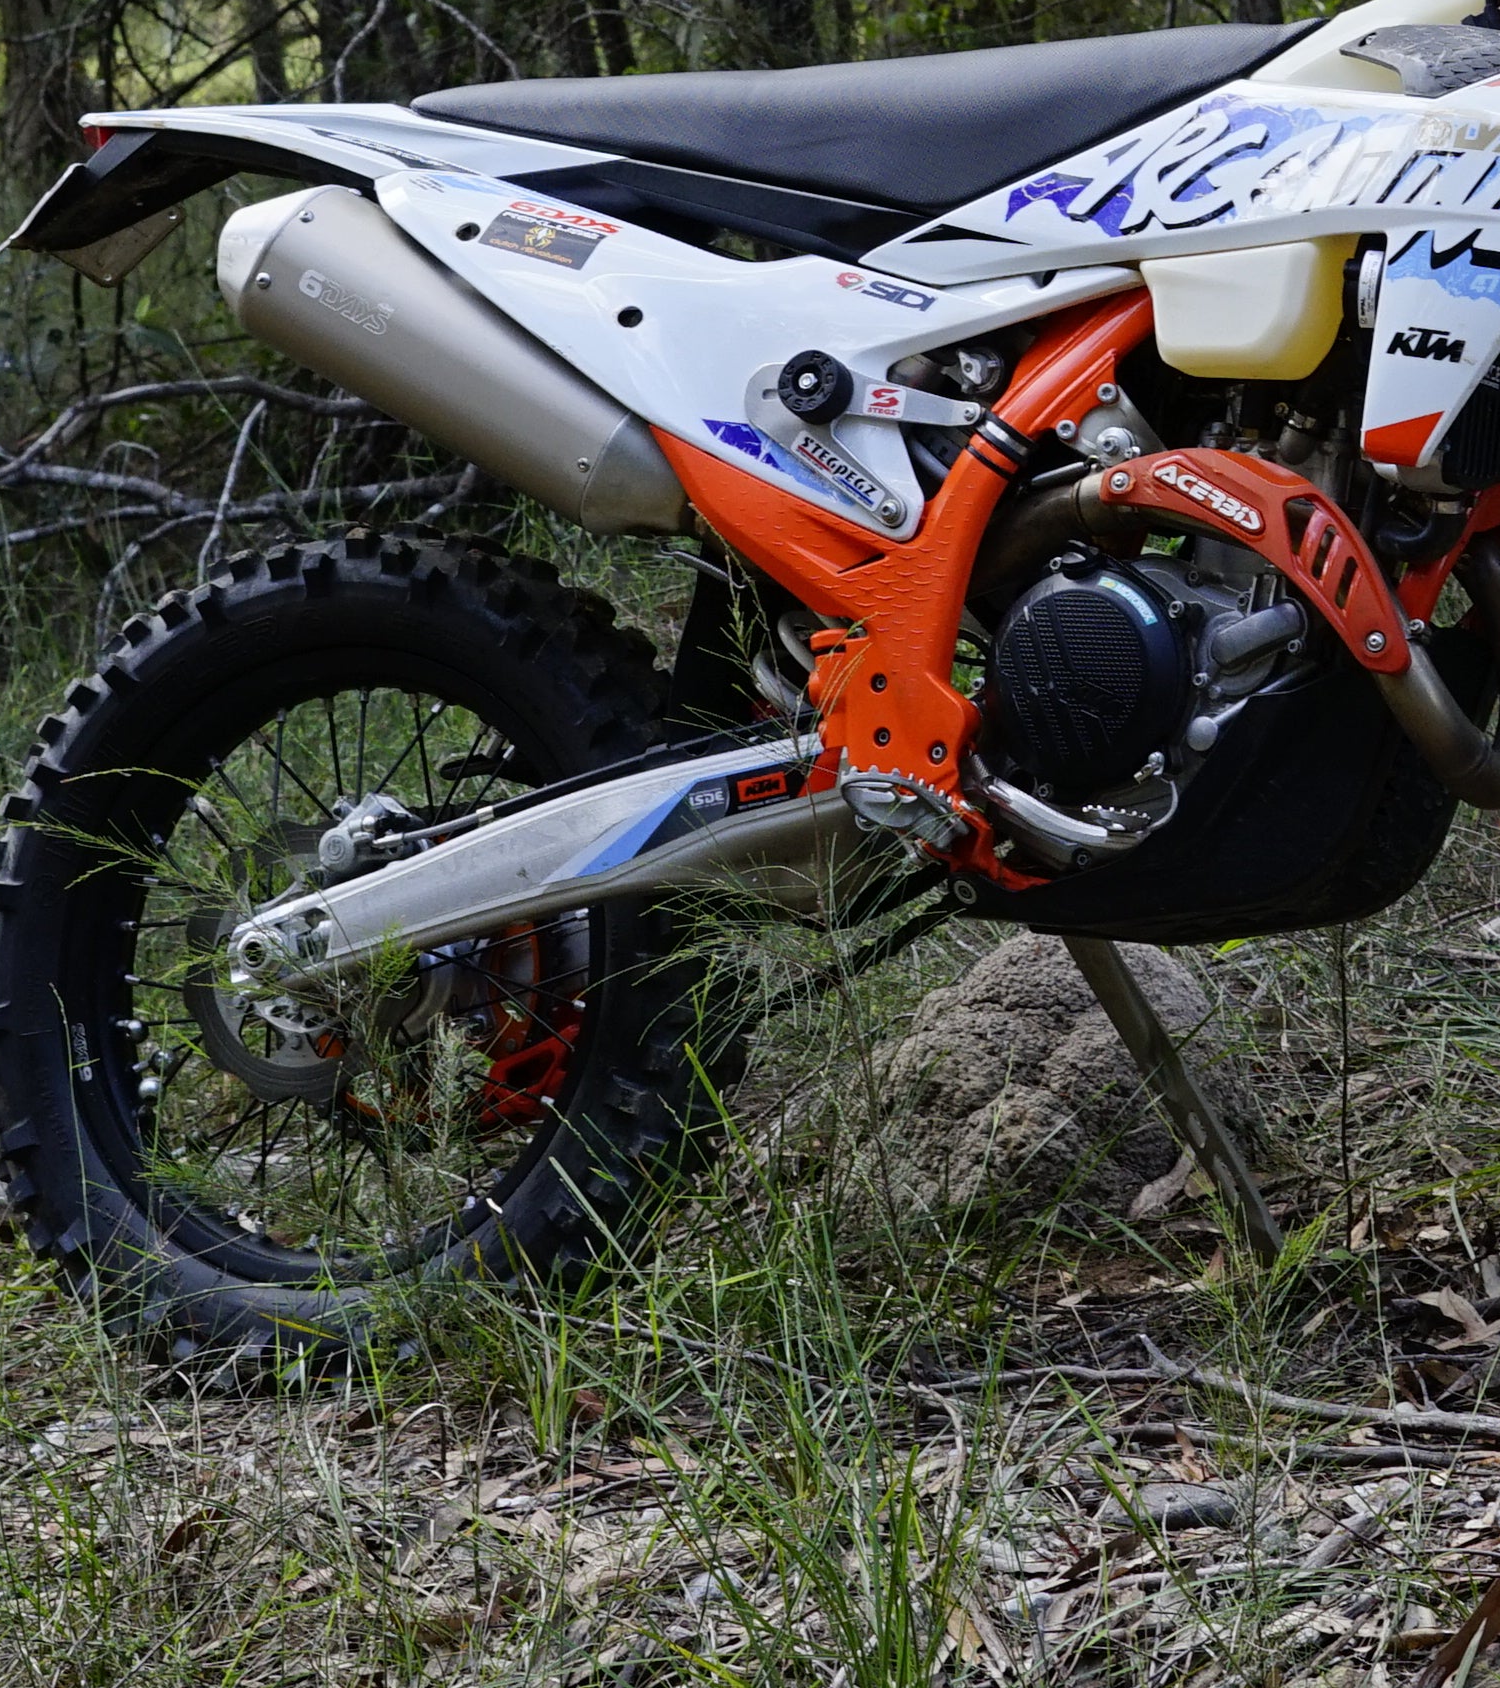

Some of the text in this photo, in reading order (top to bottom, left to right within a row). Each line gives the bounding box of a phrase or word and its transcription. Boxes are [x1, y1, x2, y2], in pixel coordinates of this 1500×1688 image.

[509, 201, 623, 234] 6DAYS
[861, 280, 938, 312] SIDI
[1386, 327, 1467, 363] KTM
[744, 779, 780, 798] KTM
